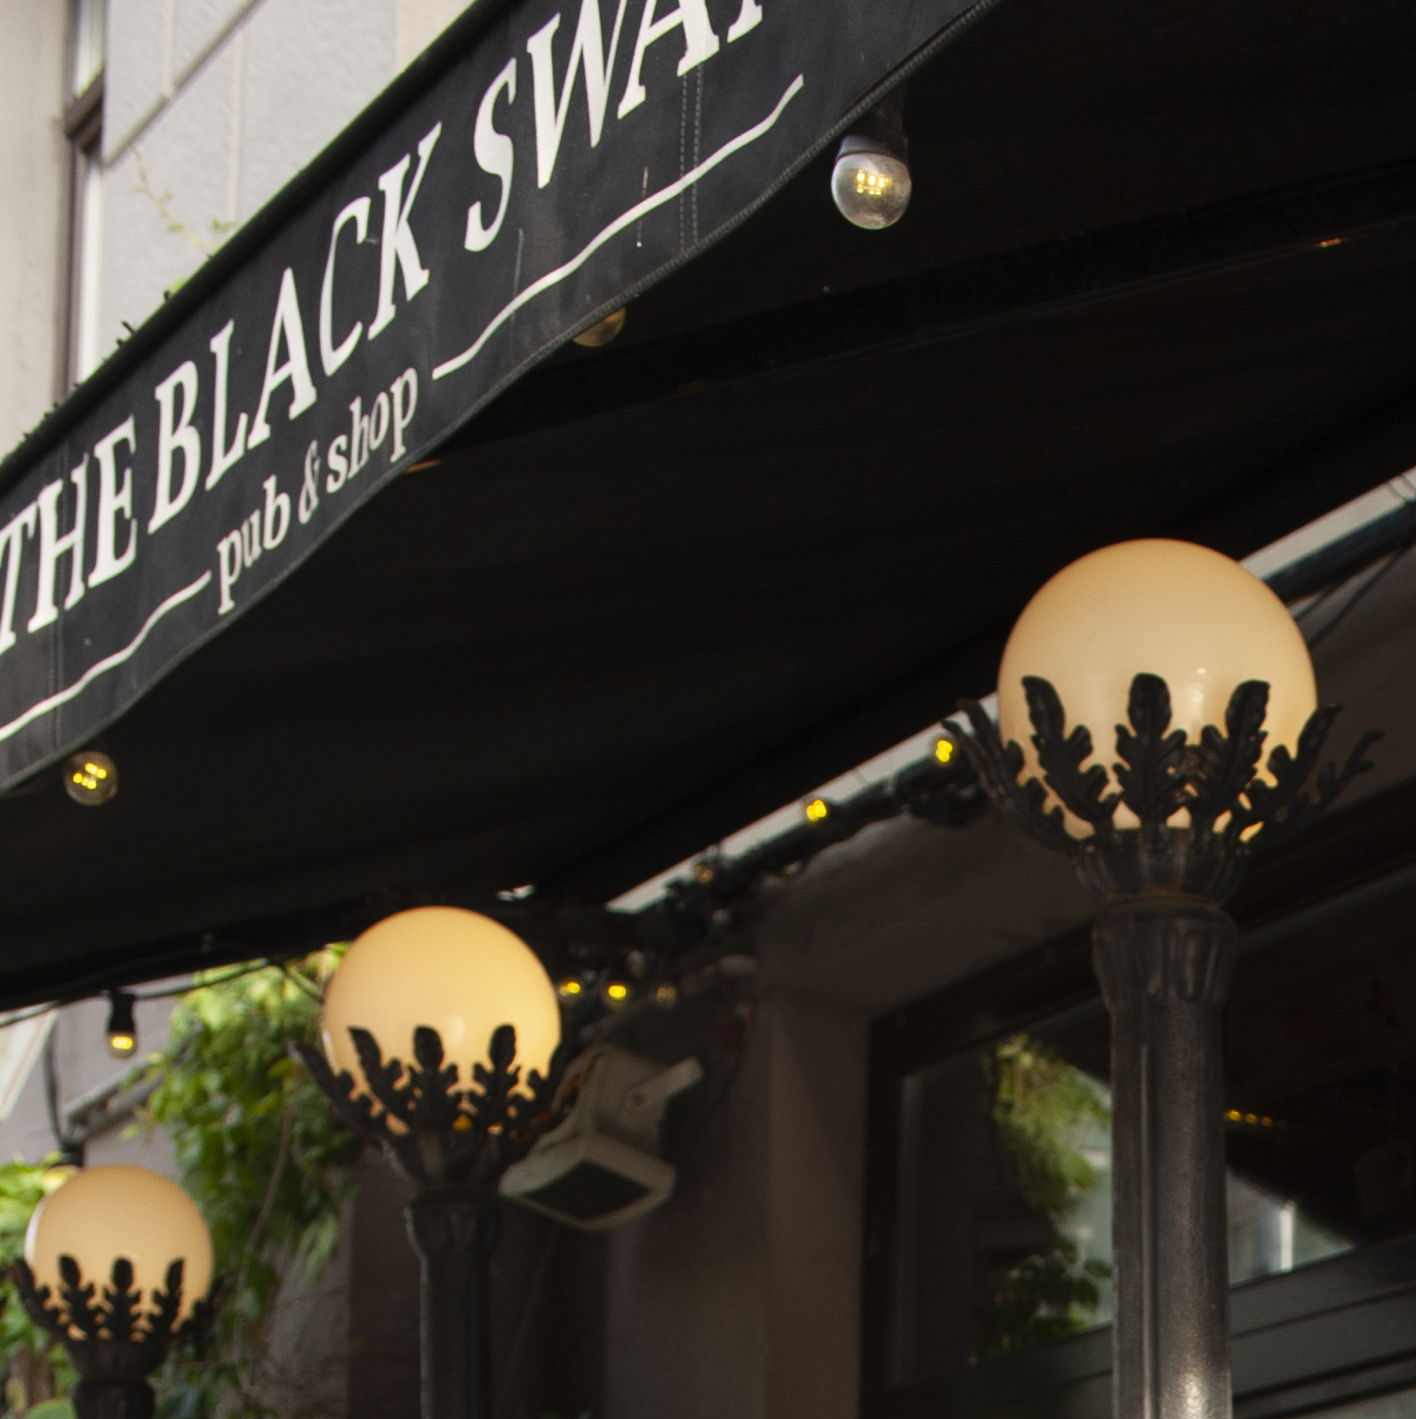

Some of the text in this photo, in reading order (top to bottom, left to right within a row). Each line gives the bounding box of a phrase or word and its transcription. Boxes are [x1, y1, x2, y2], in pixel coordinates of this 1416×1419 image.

[0, 0, 763, 656] THE BLACK SWA
[216, 366, 418, 615] pub & shop
